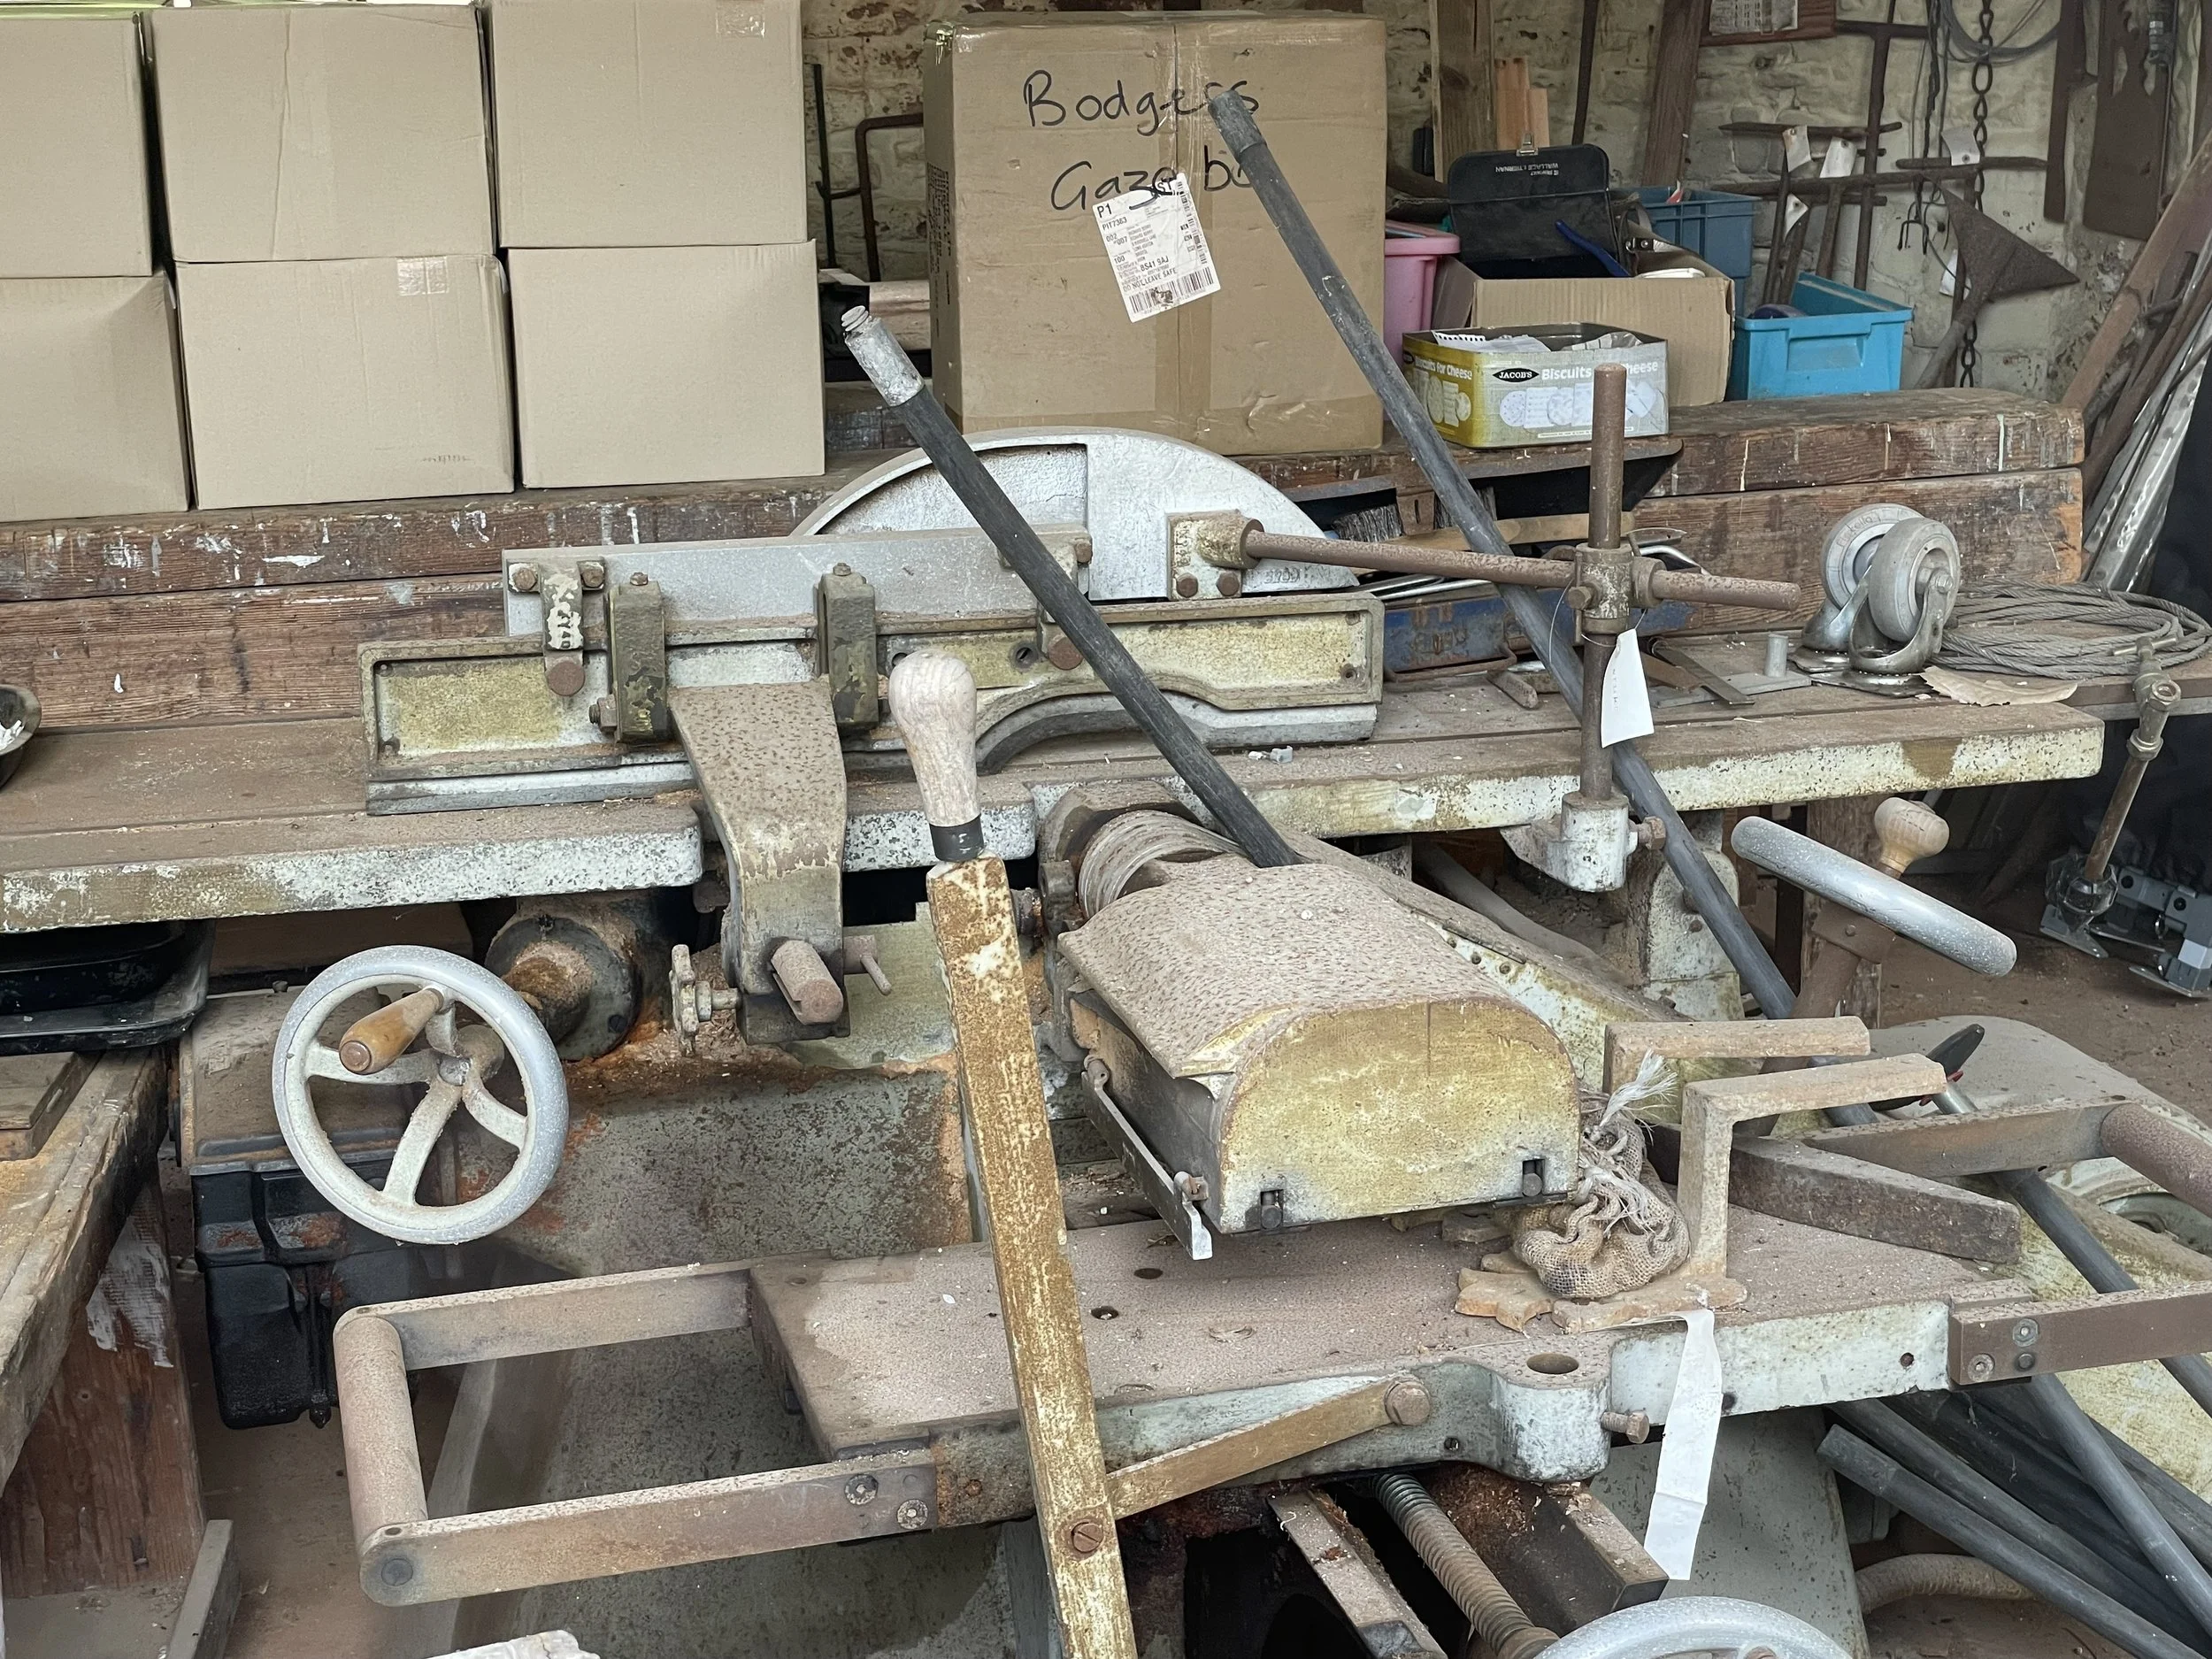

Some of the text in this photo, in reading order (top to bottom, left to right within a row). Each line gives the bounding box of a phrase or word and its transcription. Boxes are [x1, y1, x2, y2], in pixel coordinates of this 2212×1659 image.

[1097, 204, 1113, 218] P1
[1145, 273, 1163, 285] LEAVE
[1164, 268, 1178, 278] SAFE
[1447, 365, 1472, 380] Cheese
[1499, 370, 1532, 379] JACOB'S
[1541, 361, 1658, 380] Biscuits heese
